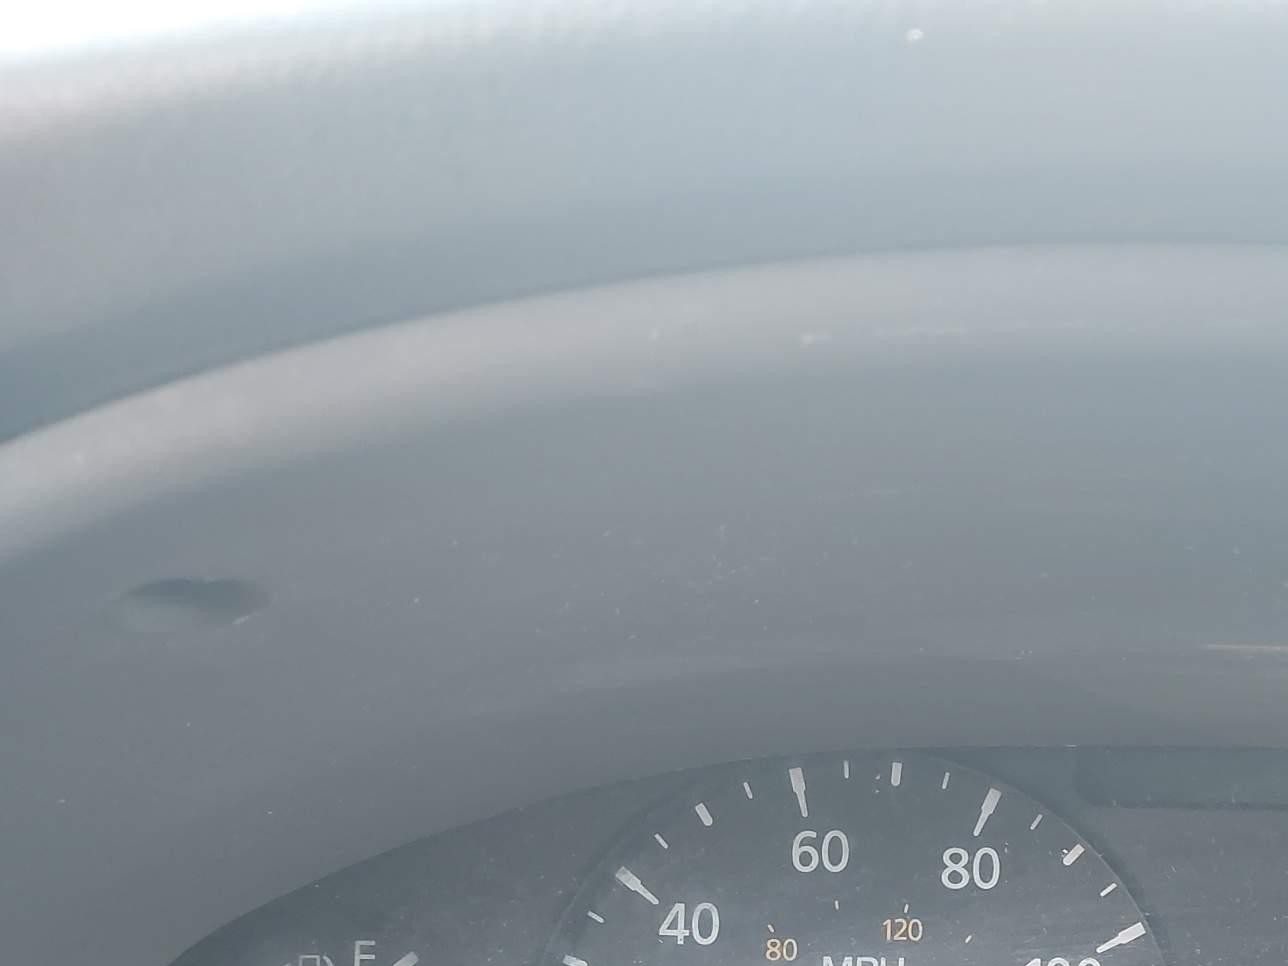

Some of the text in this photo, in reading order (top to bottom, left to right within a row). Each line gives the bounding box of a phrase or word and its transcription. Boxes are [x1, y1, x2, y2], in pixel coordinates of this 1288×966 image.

[791, 830, 850, 873] 60
[941, 847, 1000, 890] 80
[658, 902, 720, 946] 40
[882, 918, 923, 942] 120
[765, 938, 798, 961] 80
